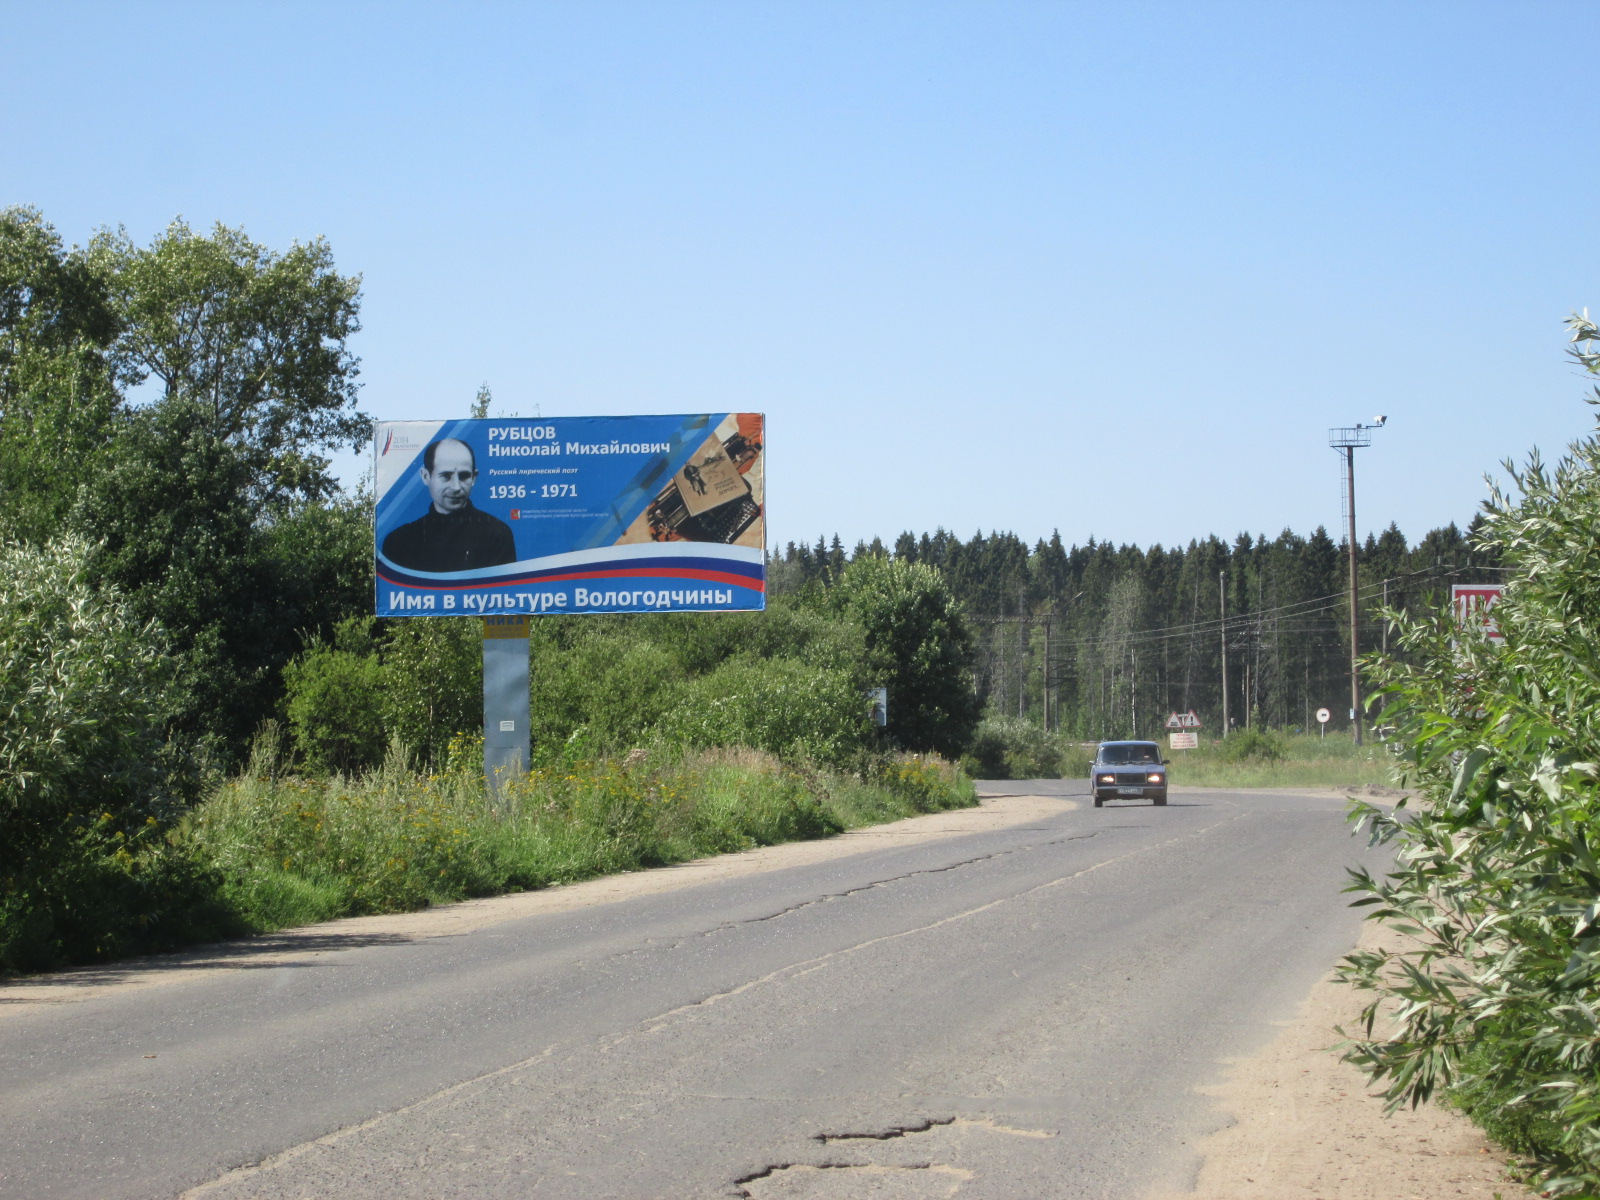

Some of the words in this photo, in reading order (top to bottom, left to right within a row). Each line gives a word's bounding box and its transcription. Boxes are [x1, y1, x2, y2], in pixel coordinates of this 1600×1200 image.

[488, 426, 556, 442] РУБЦОВ
[488, 442, 561, 457] Николай
[566, 440, 671, 455] Михайлович
[489, 468, 517, 476] Русский
[519, 468, 561, 476] лирический
[489, 485, 526, 498] 1936
[541, 484, 578, 498] 1971
[389, 591, 435, 610] Имя
[443, 594, 456, 609] в
[463, 591, 567, 613] культуре
[575, 588, 732, 608] Вологодчины
[486, 616, 525, 626] НИКА
